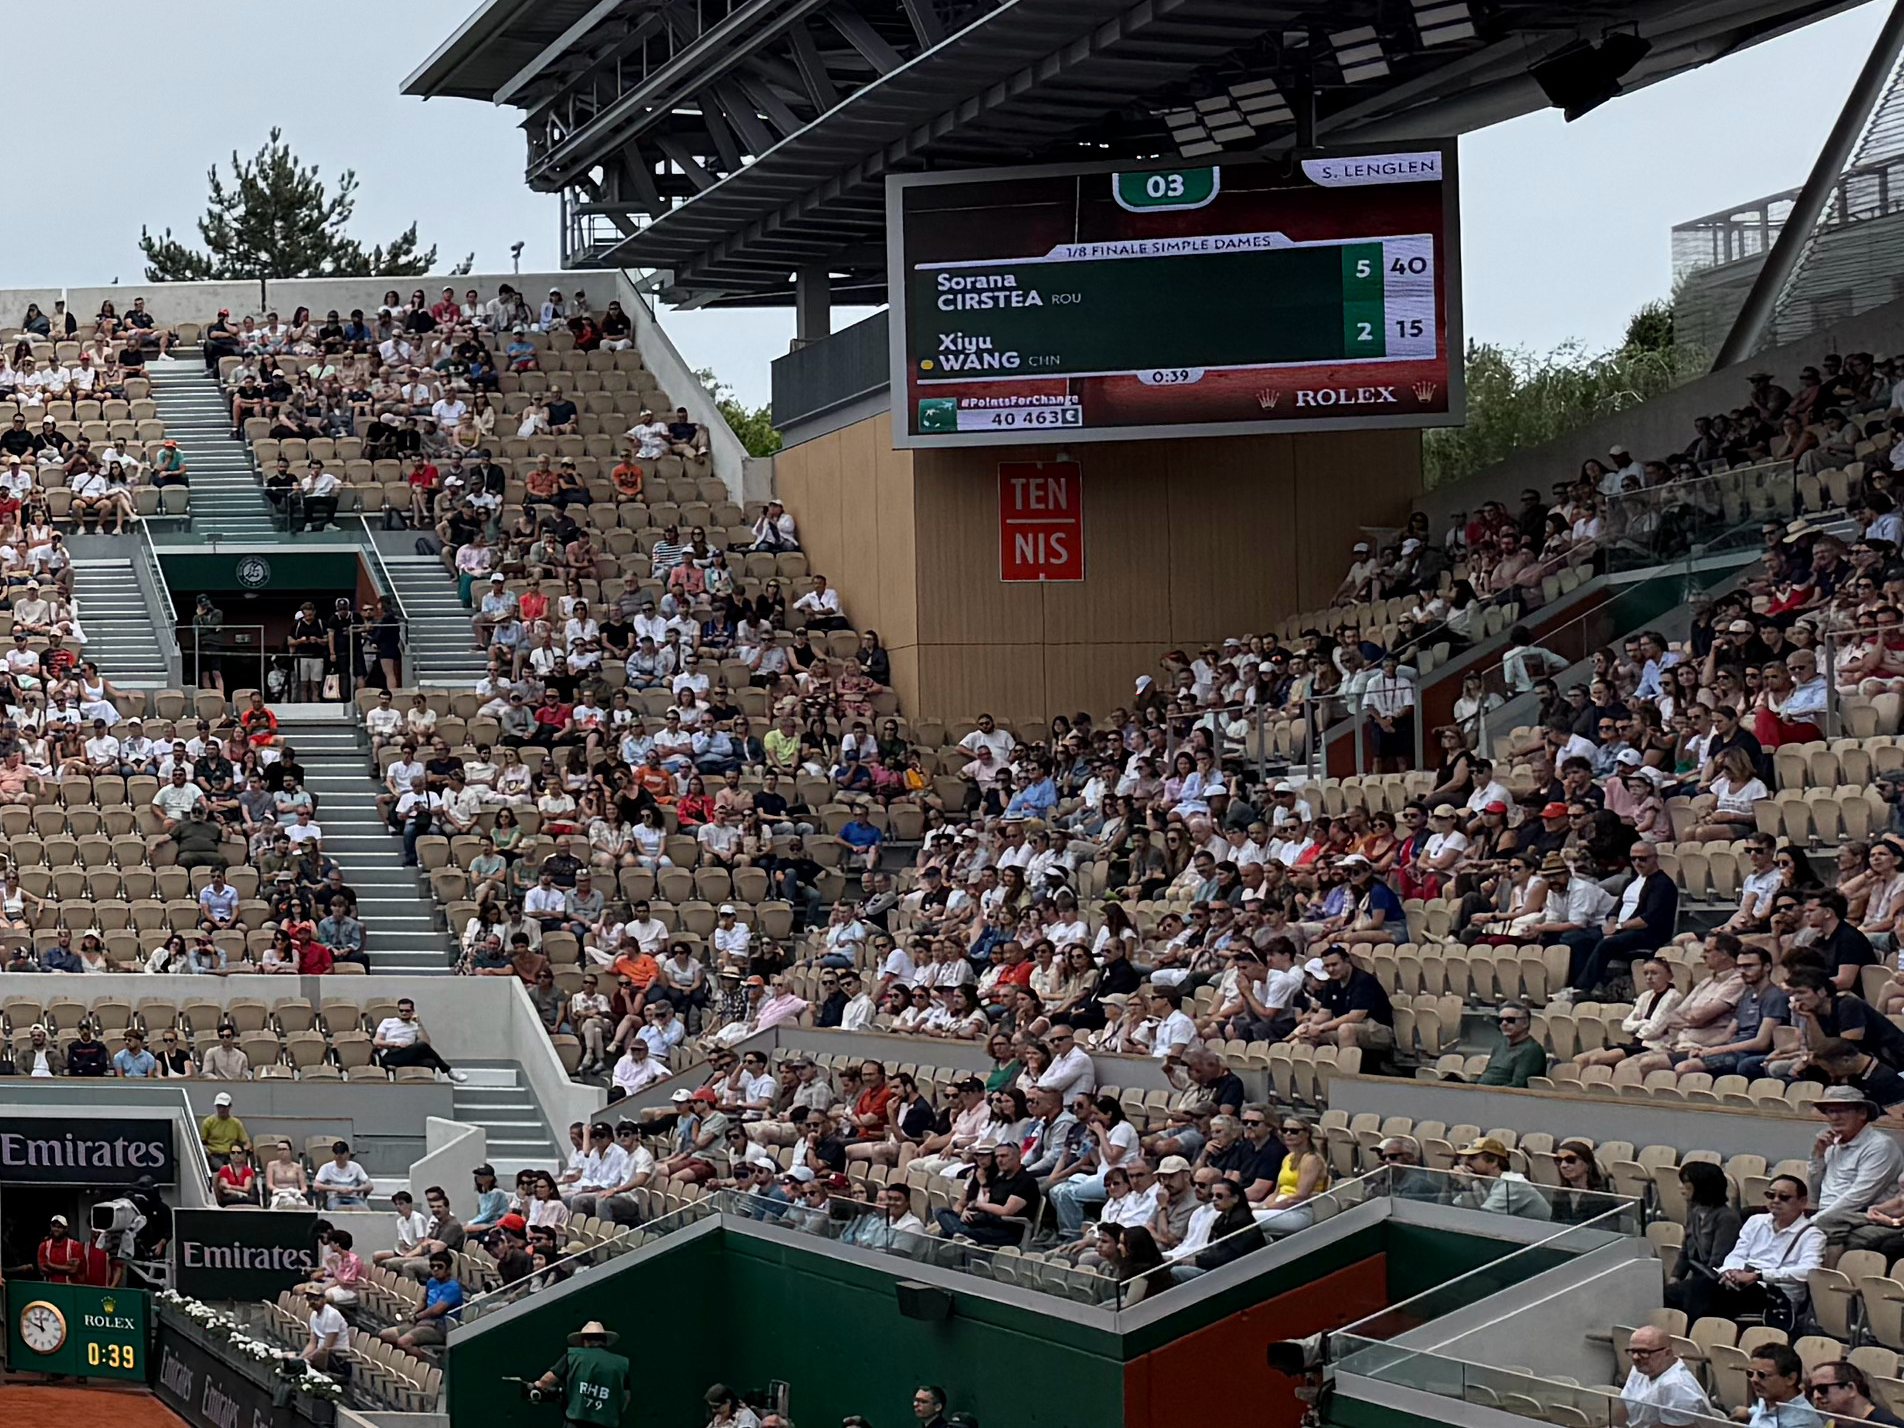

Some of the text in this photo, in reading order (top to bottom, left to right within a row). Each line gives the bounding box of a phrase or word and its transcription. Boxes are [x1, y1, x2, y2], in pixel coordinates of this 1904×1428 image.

[1322, 160, 1434, 179] S. LENGLEN
[1146, 174, 1184, 198] 03
[1066, 236, 1271, 258] 1/8 FINALE SIMPLE DAMES
[1356, 259, 1371, 279] 5
[1390, 256, 1427, 275] 40
[937, 273, 1017, 291] Sorana
[937, 289, 1082, 311] CIRSTEA ROU
[1357, 322, 1373, 341] 2
[1395, 319, 1424, 339] 15
[938, 331, 993, 354] Xiyu
[938, 351, 1061, 371] WANG CHN
[1152, 369, 1189, 384] 0:39
[960, 393, 1079, 409] #PointsForChange
[1296, 386, 1398, 408] ROLEX
[991, 412, 1016, 427] 40
[1022, 410, 1060, 425] 463
[1009, 477, 1068, 512] TEN
[1014, 531, 1069, 565] NIS
[0, 1132, 166, 1169] Emirates
[183, 1241, 313, 1271] Emirates
[84, 1314, 136, 1330] ROLEX
[87, 1342, 135, 1369] 0:39
[579, 1381, 610, 1400] RHB
